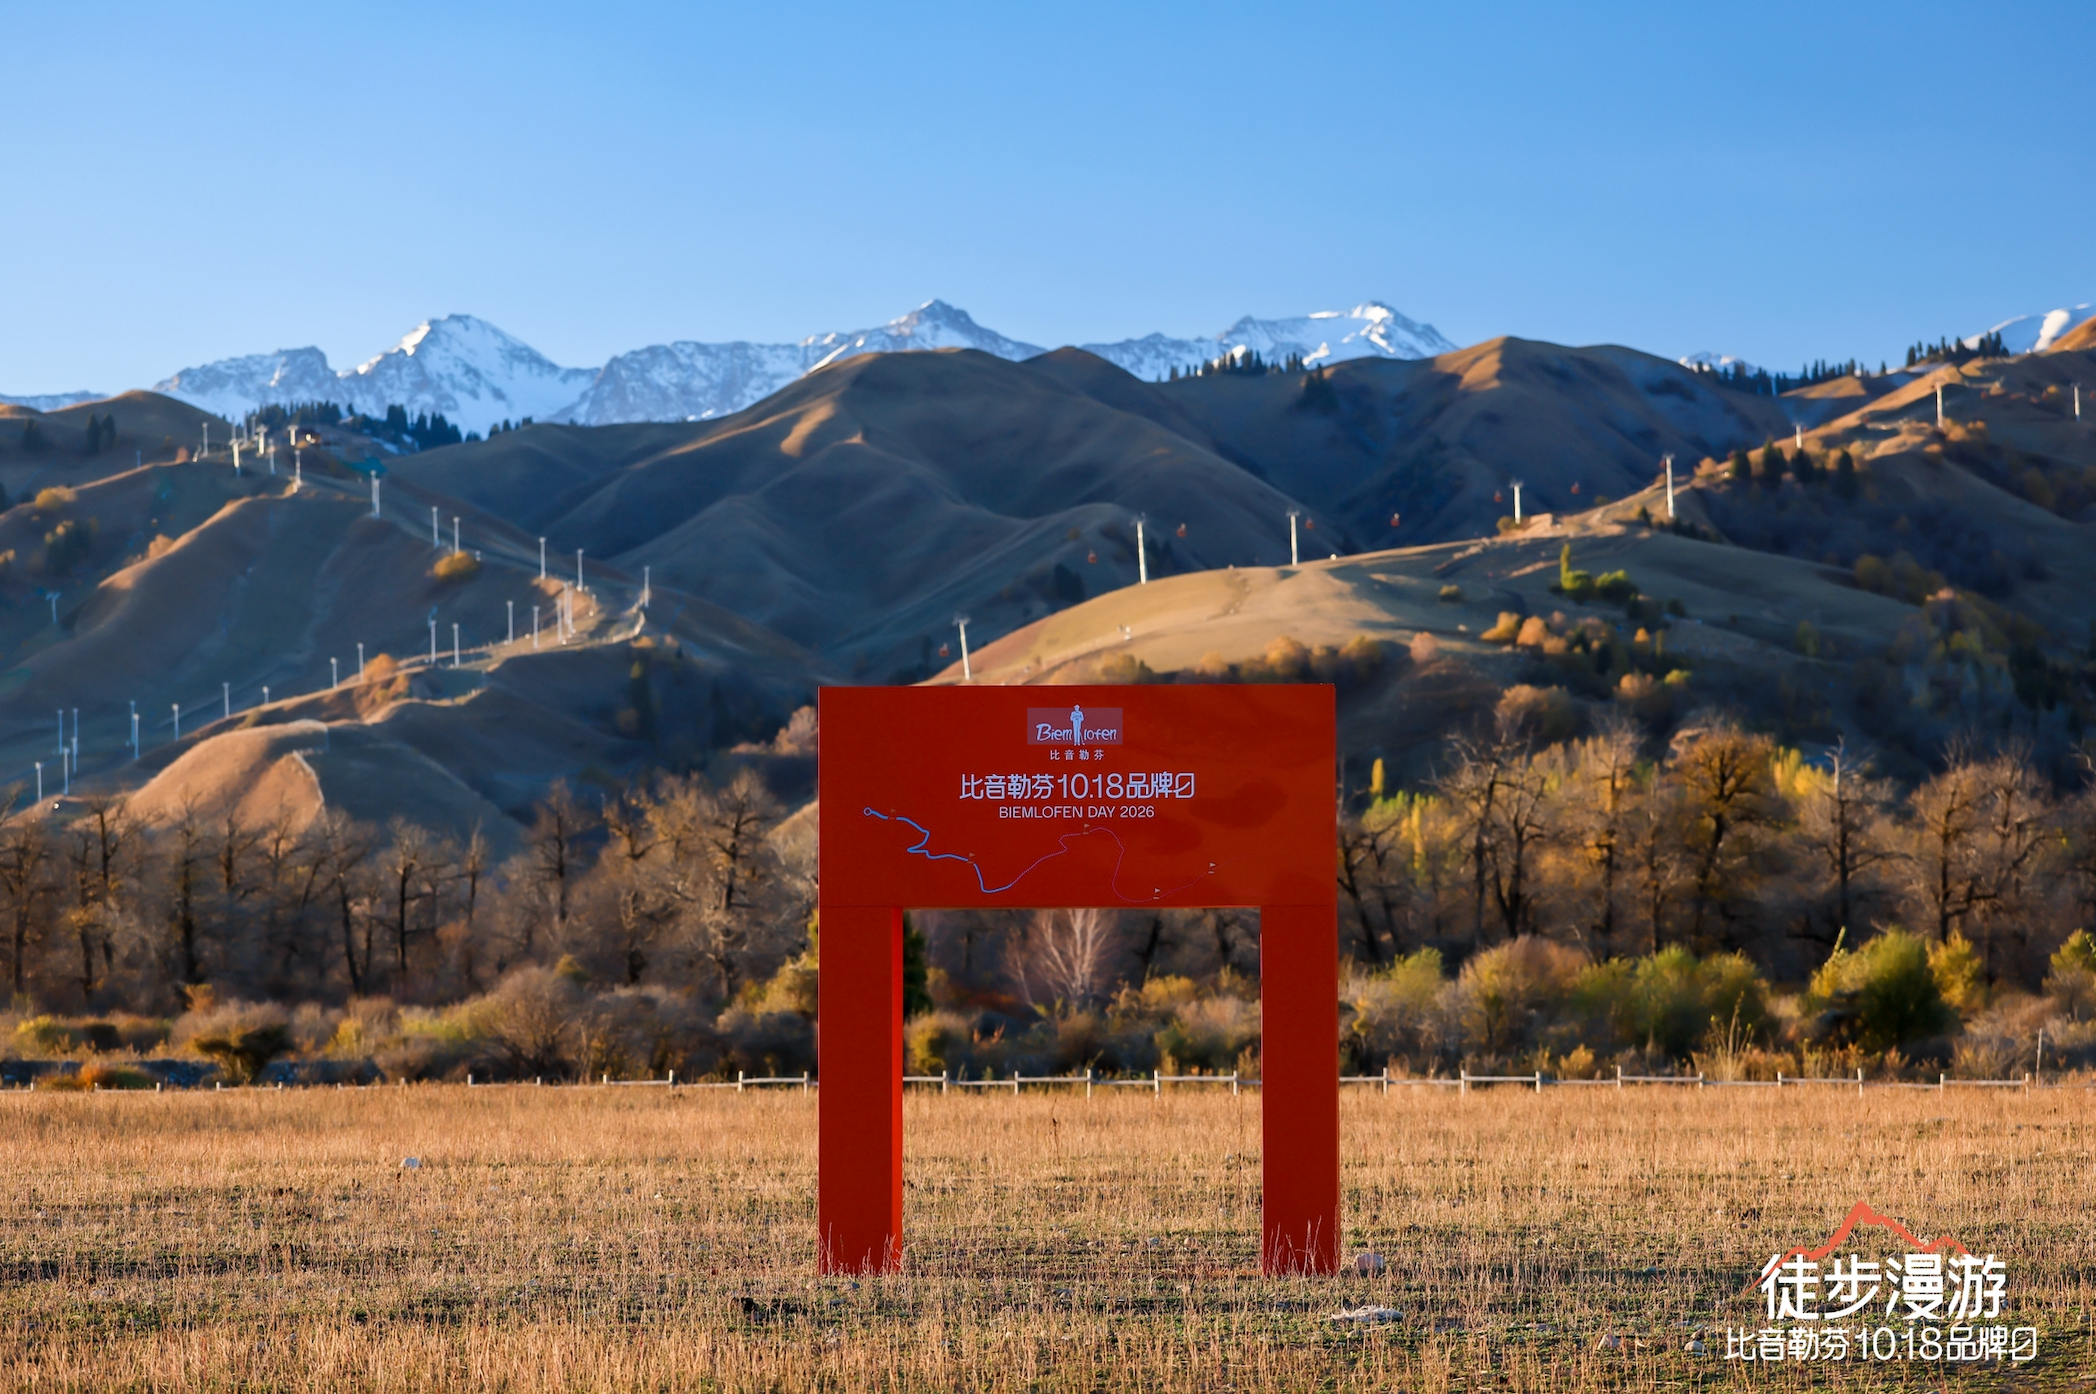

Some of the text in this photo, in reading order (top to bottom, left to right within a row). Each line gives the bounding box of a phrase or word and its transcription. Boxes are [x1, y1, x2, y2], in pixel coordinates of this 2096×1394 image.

[1050, 748, 1104, 761] 比音勒芬
[999, 805, 1155, 819] BIEMLOFEN DAY 2026
